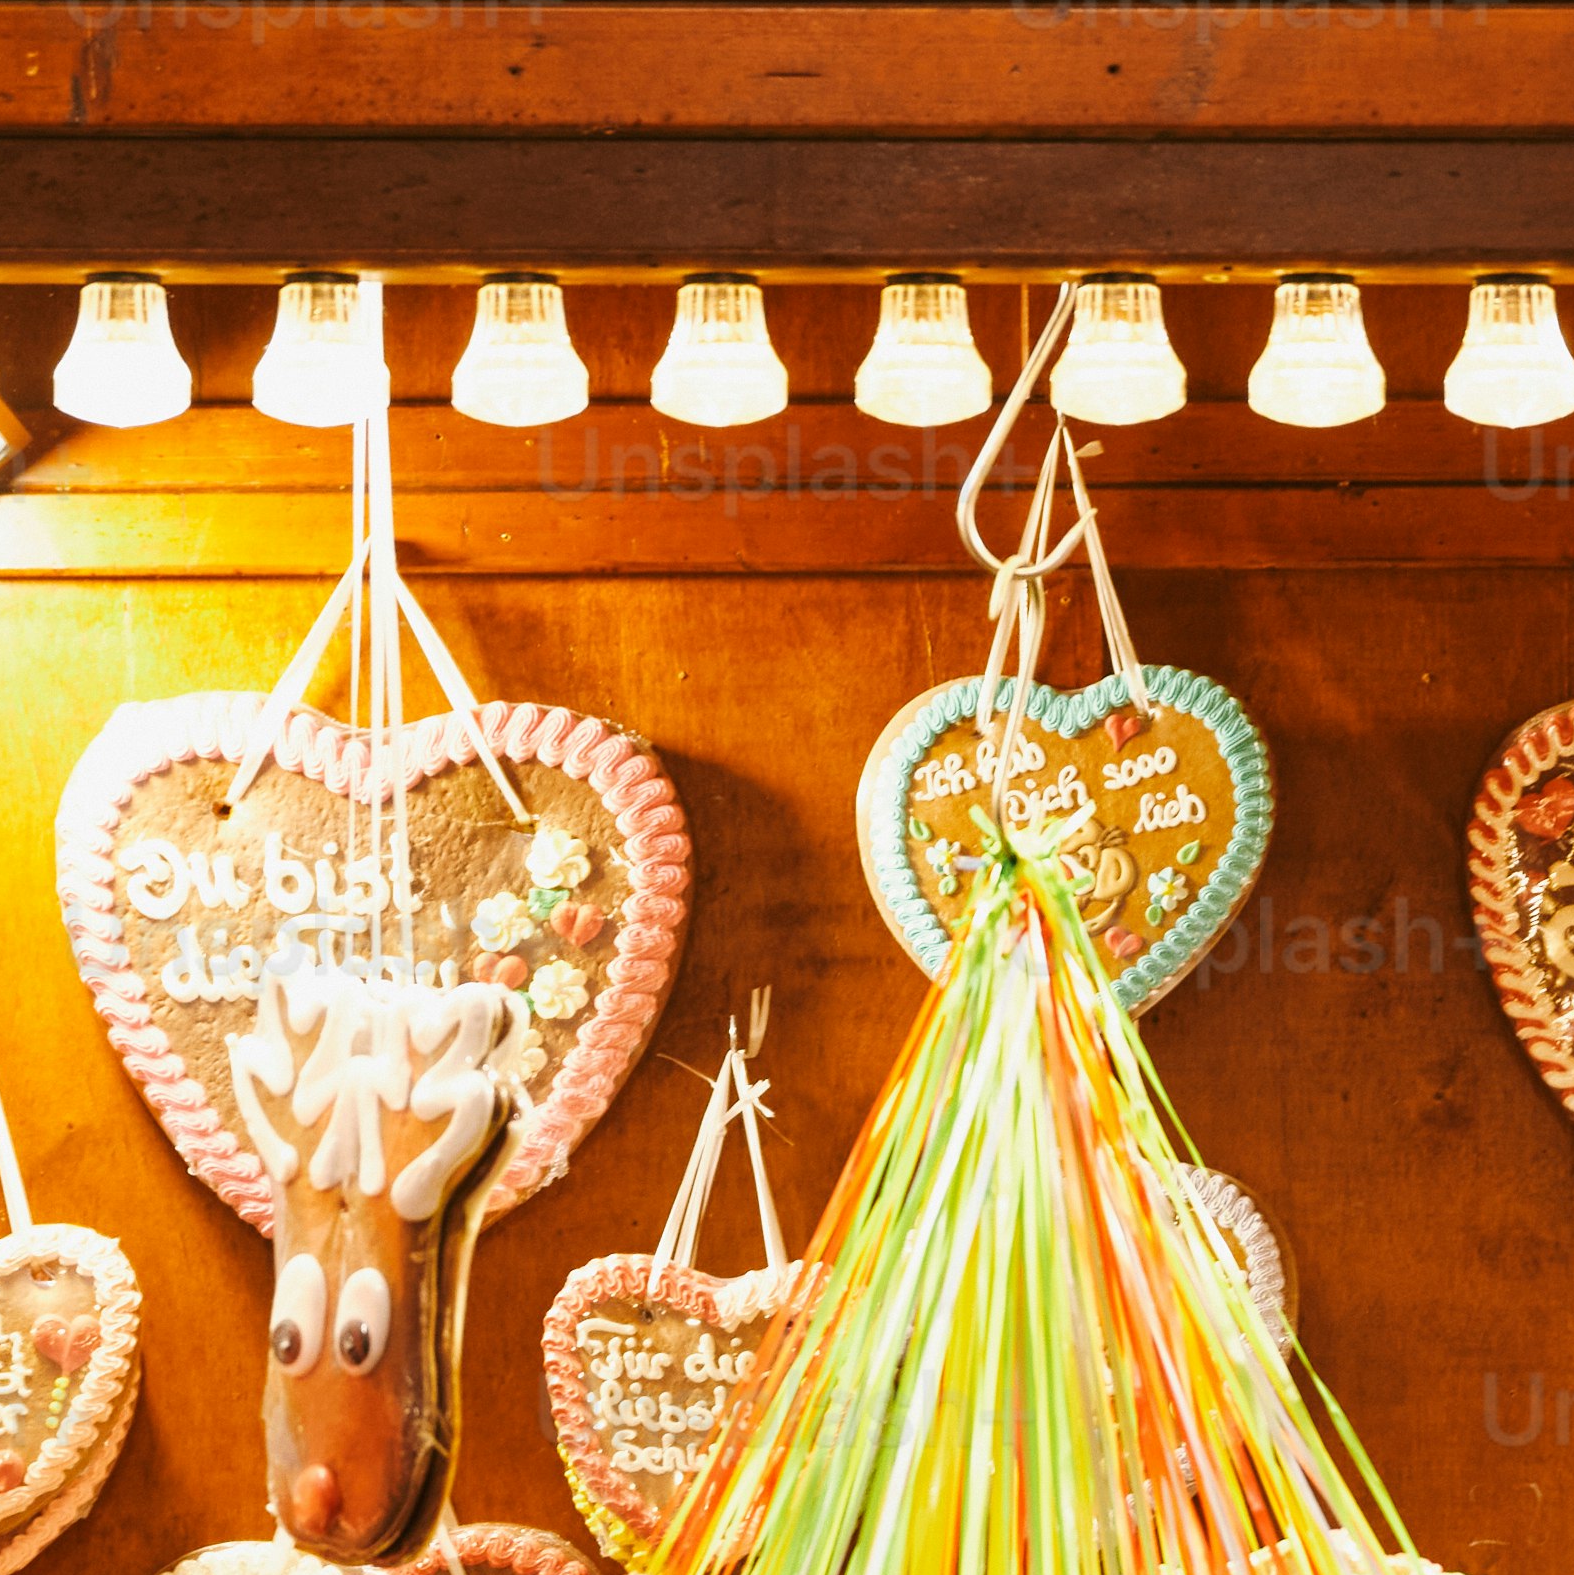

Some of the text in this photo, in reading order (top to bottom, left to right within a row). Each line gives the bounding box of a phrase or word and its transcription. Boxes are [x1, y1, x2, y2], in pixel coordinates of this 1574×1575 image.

[914, 753, 976, 801] Ich
[1102, 746, 1177, 790] sooo
[1005, 765, 1089, 830] Dich
[1133, 784, 1207, 833] lieb
